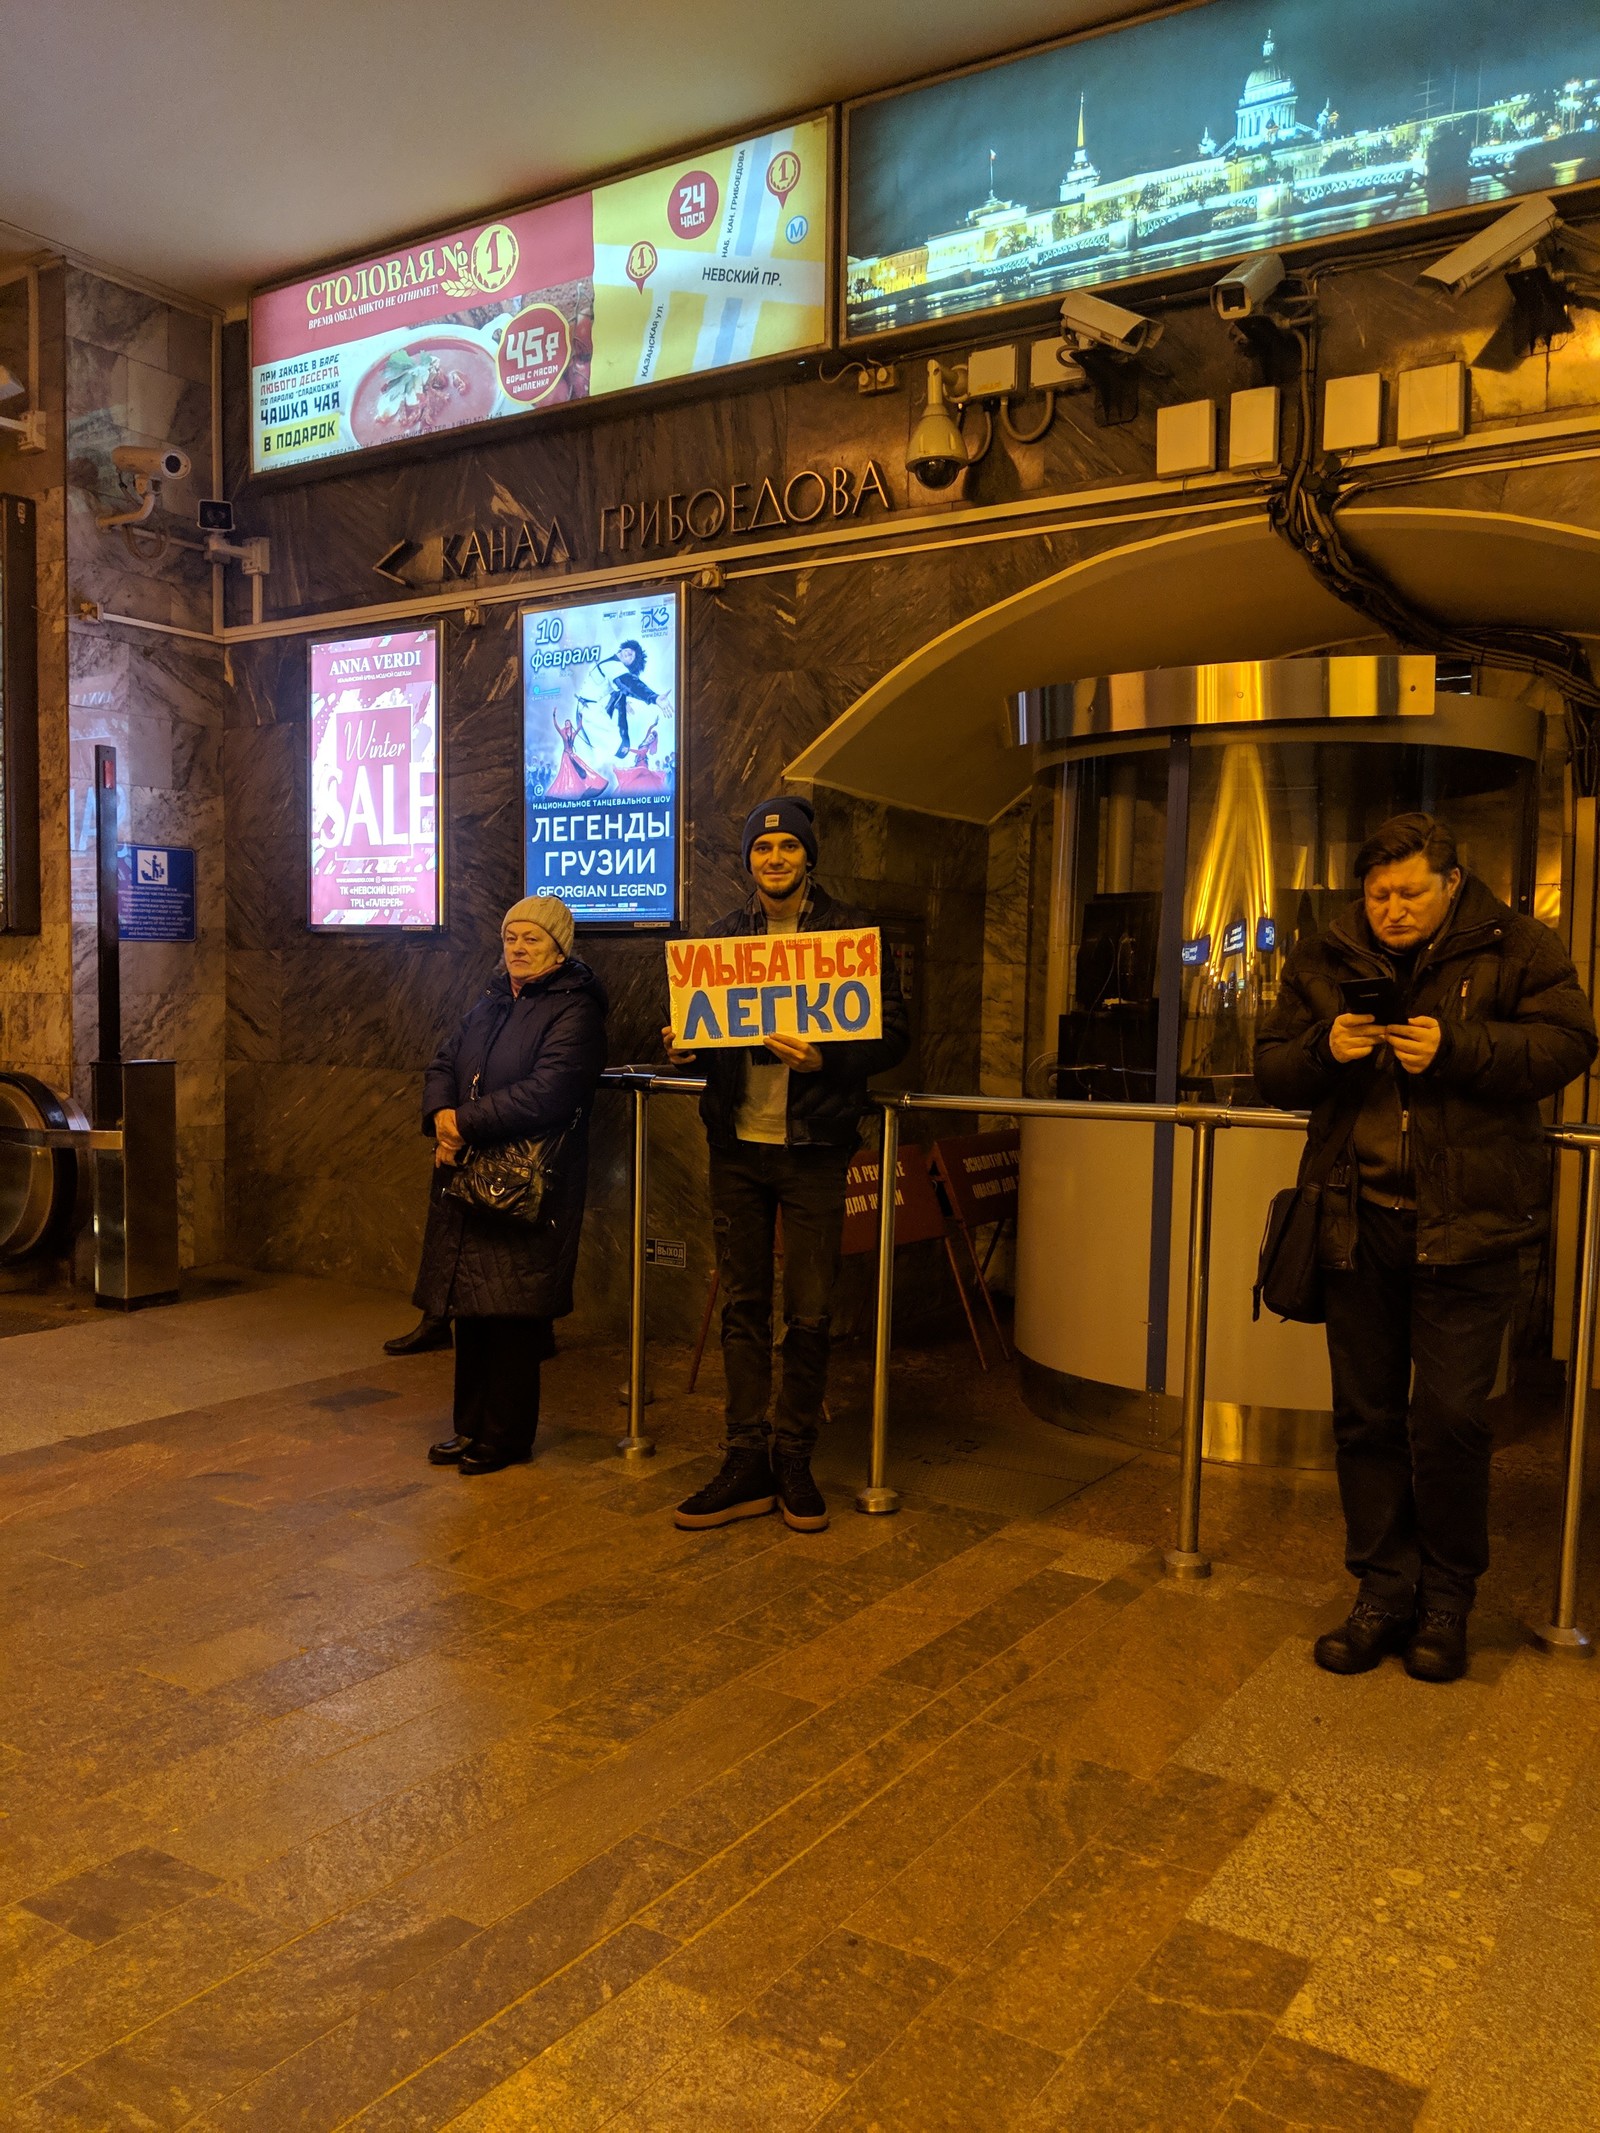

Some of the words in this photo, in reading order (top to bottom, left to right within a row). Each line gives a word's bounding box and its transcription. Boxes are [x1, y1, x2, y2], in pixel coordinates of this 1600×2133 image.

[730, 149, 745, 210] ГРИБОЕДОВА
[680, 182, 706, 215] 24
[680, 211, 706, 228] ЧАСА
[727, 212, 735, 234] КАН.
[721, 238, 732, 258] НАБ.
[306, 248, 436, 315] СТОЛОВАЯ
[437, 241, 469, 276] №
[701, 267, 760, 284] НЕВСКИЙ
[762, 272, 782, 287] ПР.
[308, 314, 334, 330] ВРЕМЯ
[333, 309, 358, 323] ОБЕДА
[358, 298, 384, 315] НИКТО
[385, 295, 396, 307] НЕ
[396, 284, 439, 304] ОТНИМЕТ!
[641, 320, 659, 377] КАЗАНСКАЯ
[656, 303, 665, 319] УЛ.
[260, 370, 276, 382] ПРИ
[279, 362, 309, 378] ЗАКАЗЕ
[312, 360, 317, 370] В
[319, 354, 340, 367] БАРЕ
[260, 378, 297, 395] ЛЮБОГО
[299, 366, 340, 387] ДЕСЕРТА
[506, 373, 526, 384] БОРЩ
[533, 364, 559, 378] МЯСОМ
[260, 397, 268, 406] ПО
[269, 392, 294, 405] ПАРОЛЮ
[512, 378, 550, 394] ЦЫПЛЕНКА
[260, 400, 308, 425] ЧАШКА
[314, 391, 340, 413] ЧАЯ
[264, 436, 271, 452] В
[276, 420, 336, 449] ПОДАРОК
[441, 514, 572, 579] КАНАЛ
[599, 459, 890, 554] ГРИБОЕДОВА
[535, 617, 564, 645] 10
[329, 657, 371, 676] ANNA
[373, 650, 422, 670] VERDI
[531, 646, 601, 673] февраля
[344, 719, 406, 762] Winter
[317, 762, 435, 848] SALE
[532, 800, 591, 810] НАЦИОНАЛЬНОЕ
[593, 797, 652, 807] ТАНЦЕВАЛЬНОЕ
[653, 795, 671, 803] ШОУ
[531, 811, 670, 843] ЛЕГЕНДЫ
[545, 848, 656, 877] ГРУЗИИ
[340, 886, 349, 895] ТК
[349, 884, 386, 896] «НЕВСКИЙ
[350, 899, 365, 908] ТРЦ
[536, 885, 607, 898] GEORGIAN
[611, 883, 667, 897] LEGEND
[670, 933, 879, 988] УЛЫБАТЬСЯ
[683, 980, 871, 1040] ЛЕГКО
[845, 1195, 868, 1217] ДЛЯ
[657, 1245, 684, 1259] ВЫХОД
